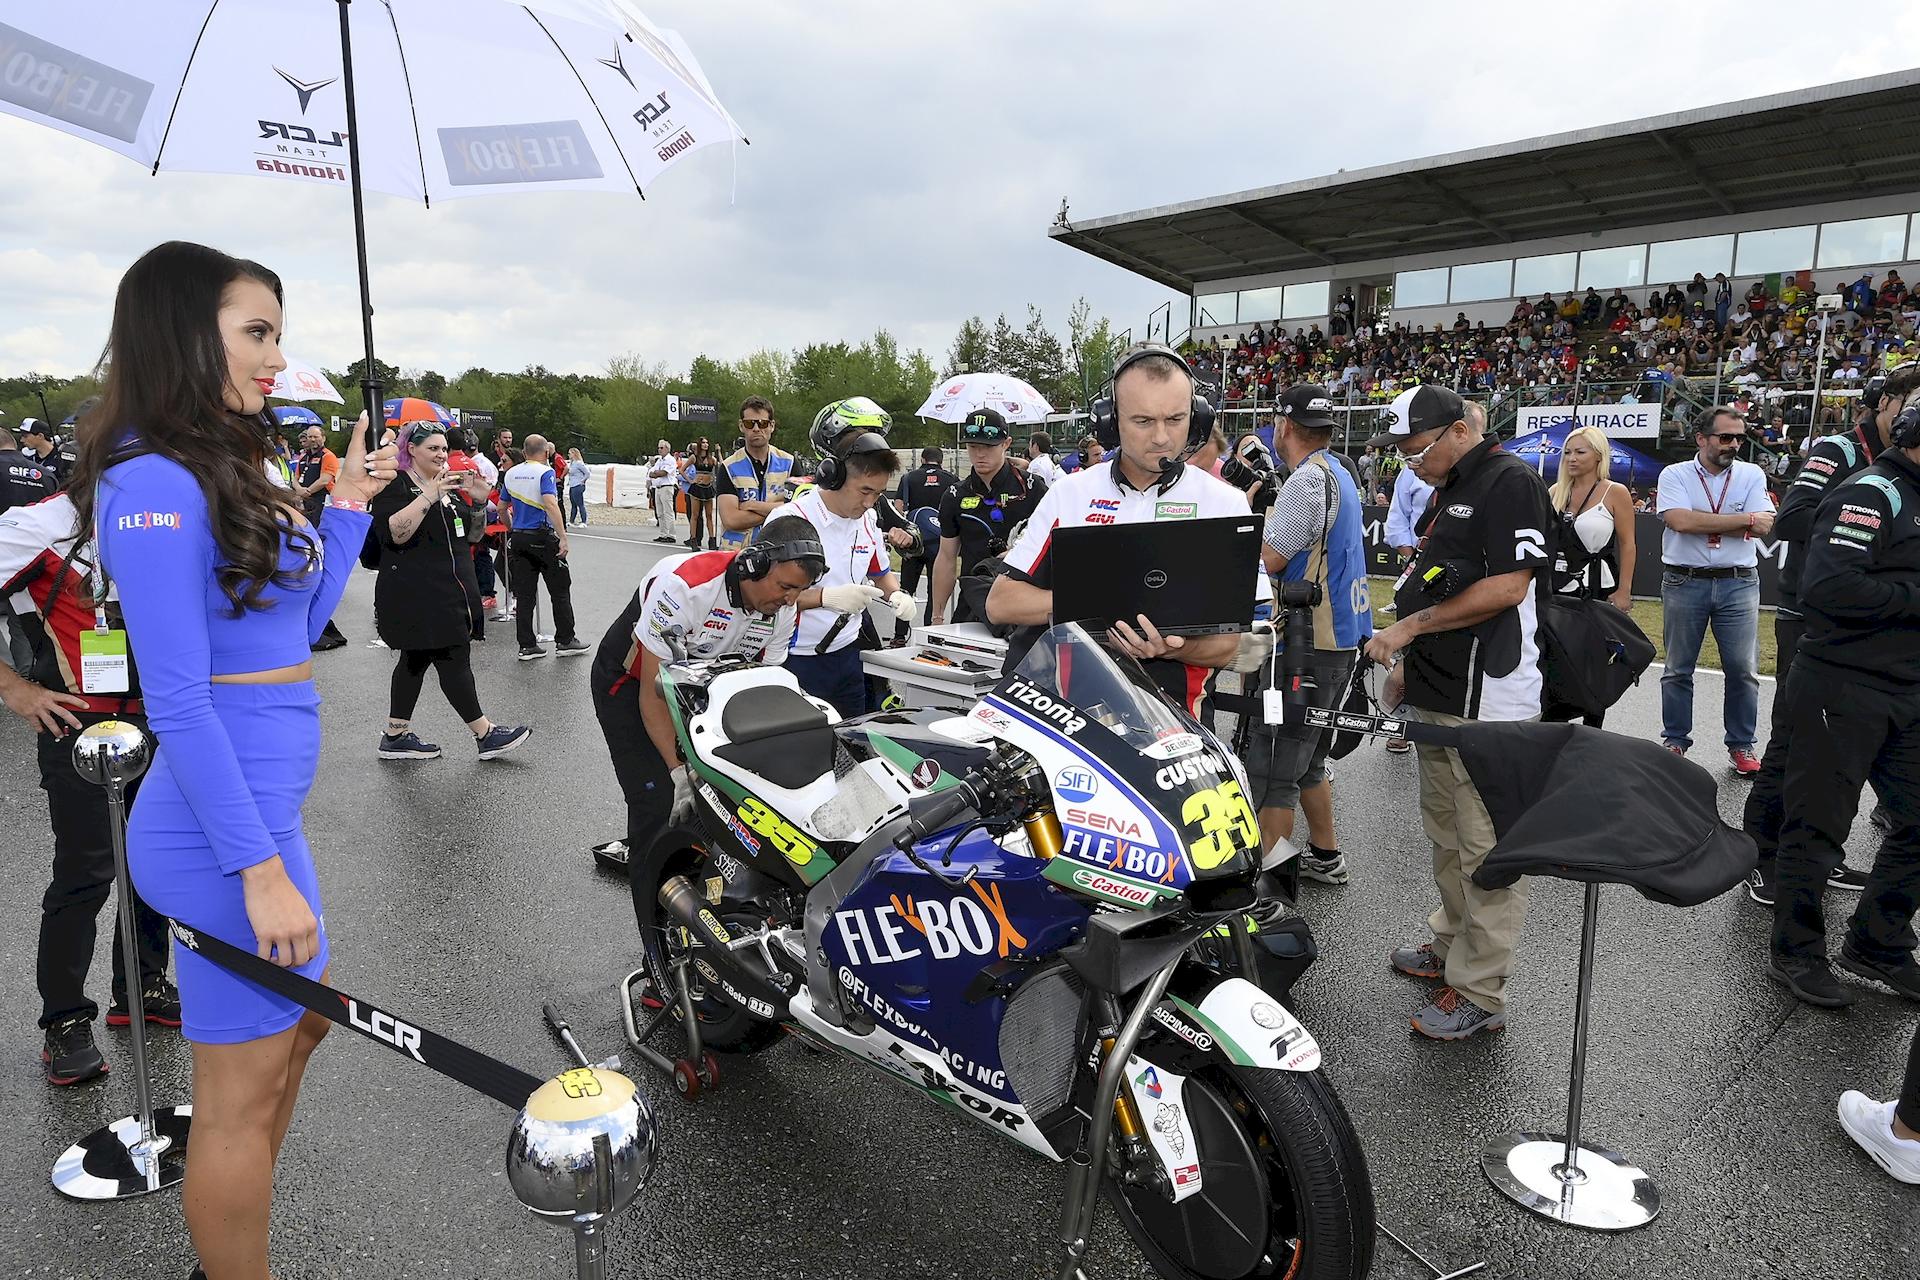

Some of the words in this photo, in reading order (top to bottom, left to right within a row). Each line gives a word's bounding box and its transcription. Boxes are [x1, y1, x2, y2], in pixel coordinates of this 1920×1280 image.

[670, 403, 677, 413] 6
[9, 466, 30, 477] elf
[743, 490, 756, 500] 32
[1089, 498, 1121, 511] HRC
[1085, 513, 1116, 524] GIVI
[1165, 506, 1192, 514] Castrol
[118, 511, 181, 531] FLEXBOX
[703, 620, 728, 631] GIVI
[1005, 680, 1087, 734] rizoma
[1345, 718, 1370, 728] Castrol
[1059, 771, 1092, 791] SIFI
[1155, 753, 1227, 791] CUSTOM
[737, 797, 818, 867] 35
[1066, 808, 1142, 838] SENA
[1181, 779, 1260, 870] 35
[727, 815, 761, 857] HRC
[1063, 829, 1181, 884] FLEXBOX
[1091, 877, 1151, 903] Castrol
[700, 910, 729, 940] ARROW
[348, 999, 426, 1063] LCR
[1288, 1047, 1320, 1068] HONDA
